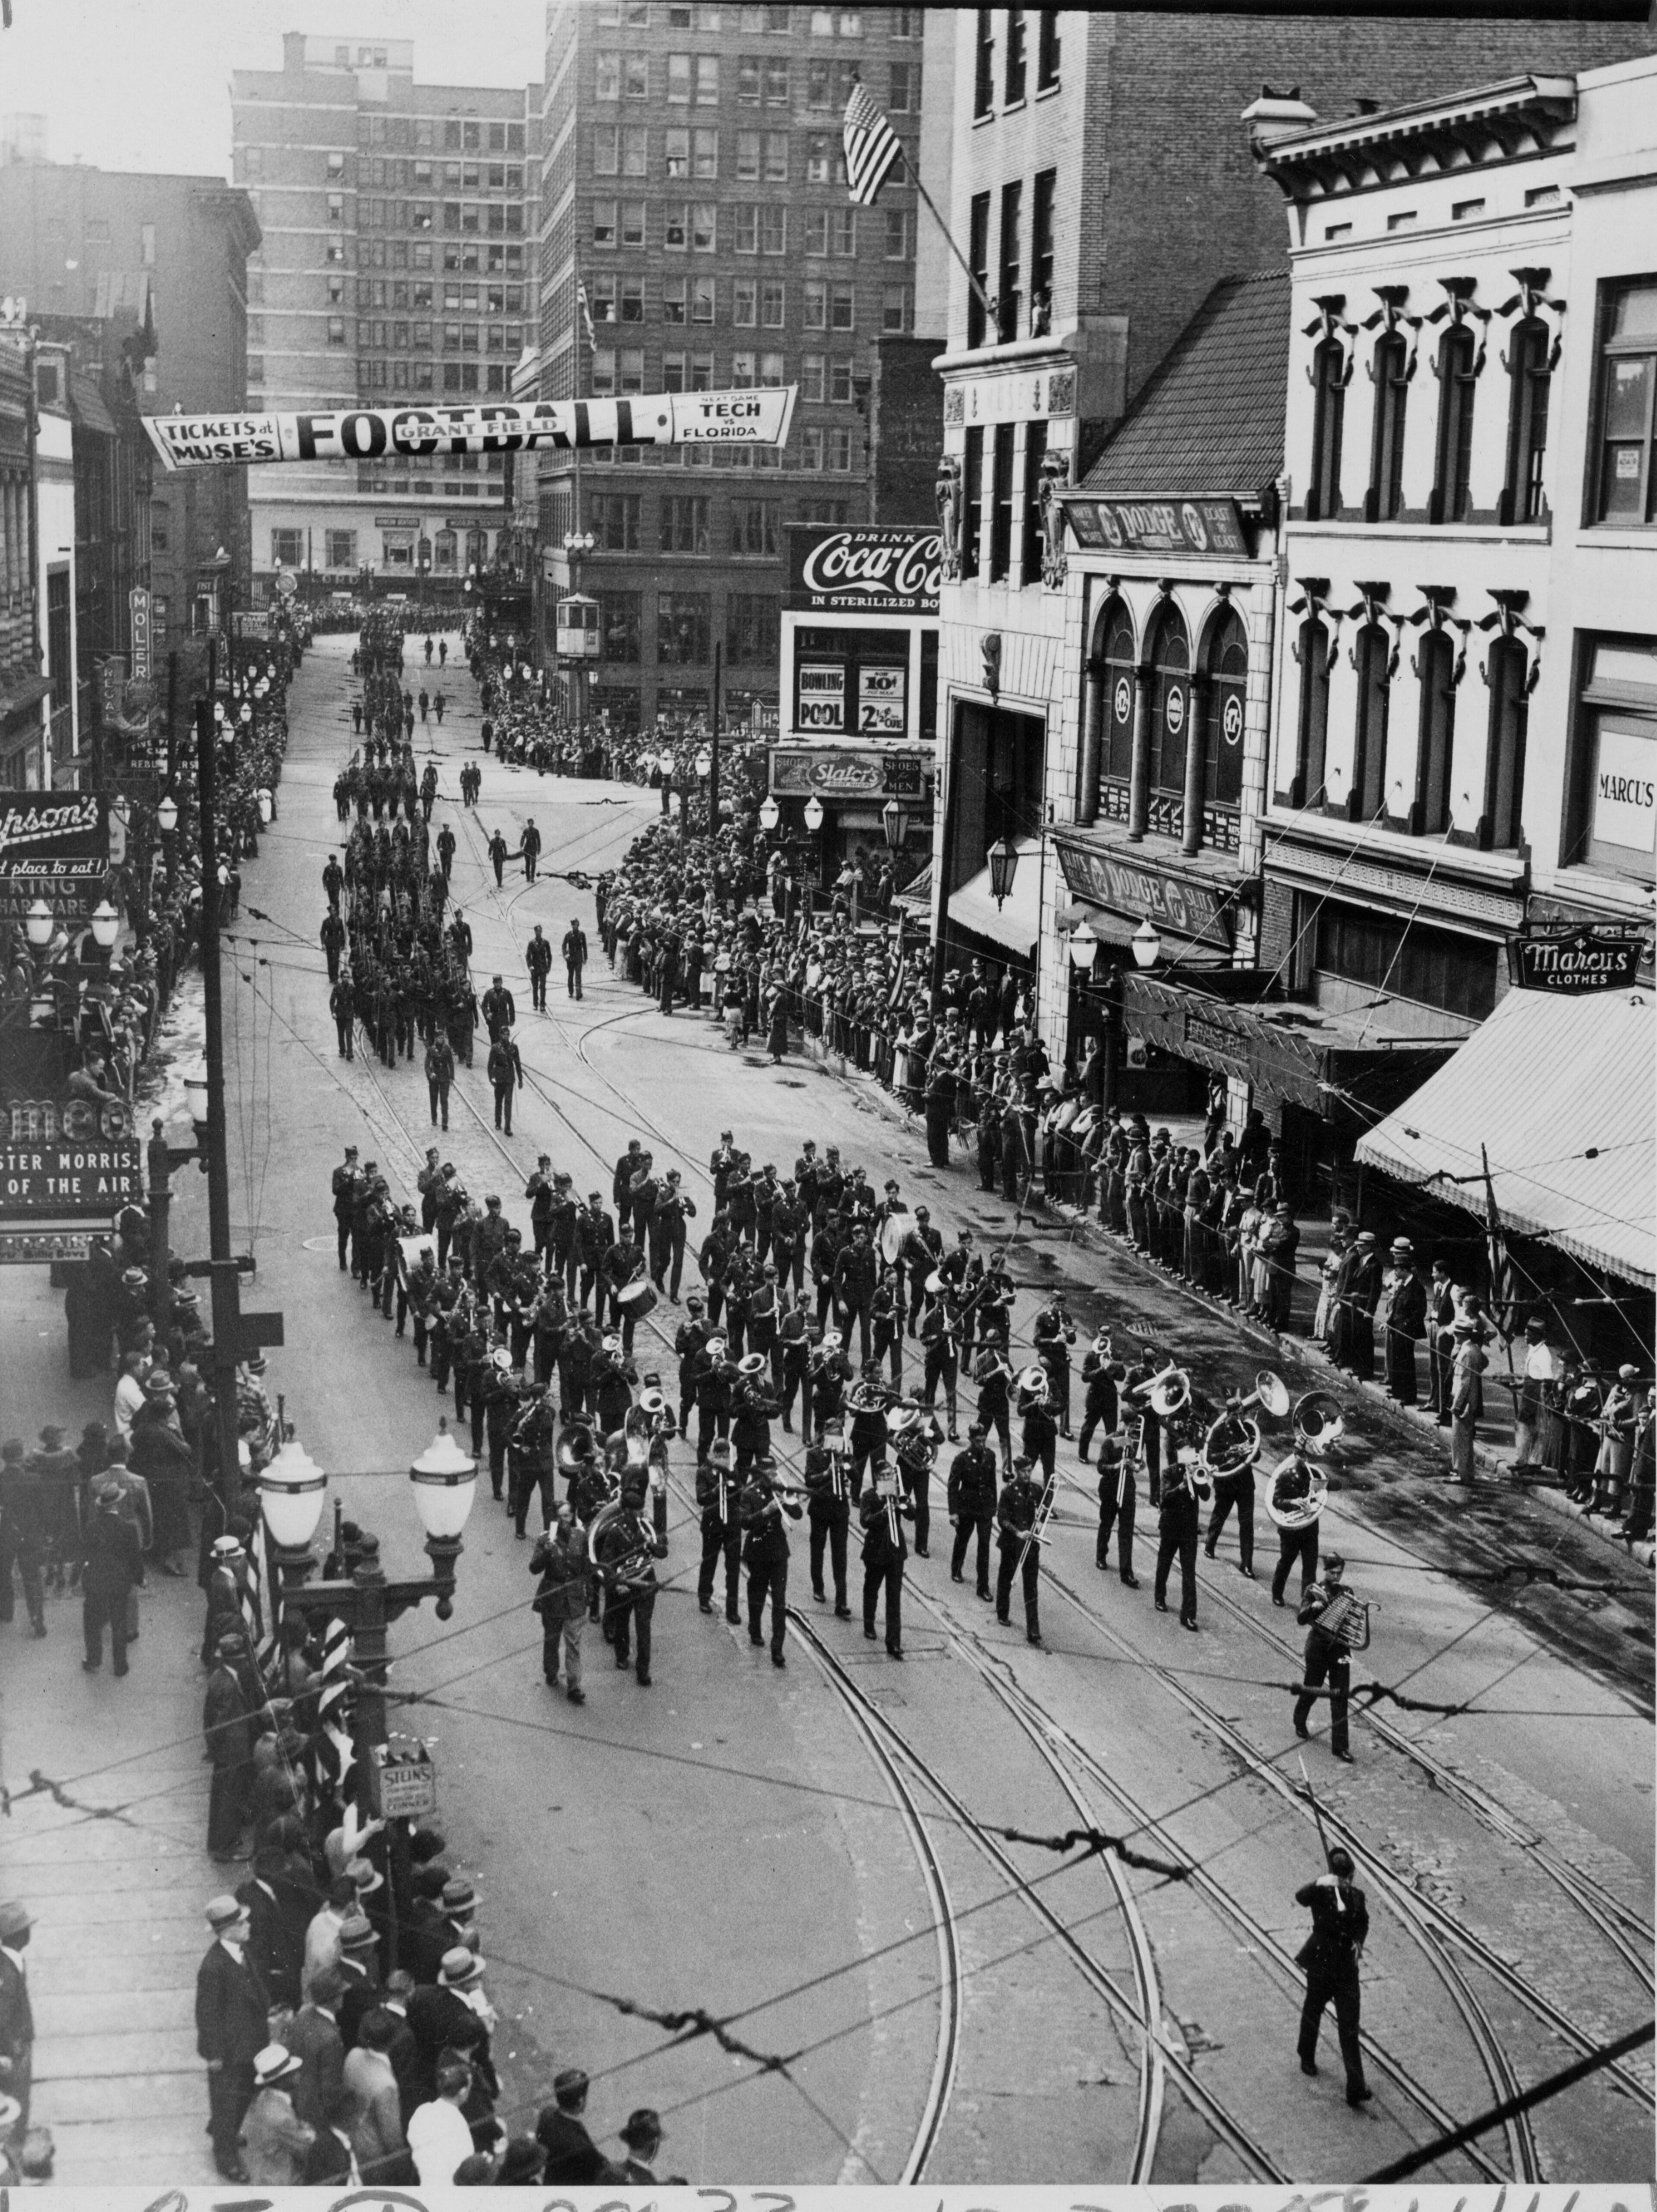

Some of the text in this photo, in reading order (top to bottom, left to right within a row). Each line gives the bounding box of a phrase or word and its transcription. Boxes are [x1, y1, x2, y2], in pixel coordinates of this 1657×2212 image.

[699, 403, 760, 417] TECH
[164, 420, 274, 441] TICKETS at
[296, 400, 655, 459] FOOTBALL
[401, 420, 558, 438] GRANT FIELD
[684, 427, 757, 438] FLORIDA
[173, 439, 274, 460] MUSE'S
[1116, 506, 1184, 539] DODGE
[854, 533, 916, 542] DRINK
[811, 595, 825, 605] IN
[830, 596, 915, 608] STERILIZED
[134, 595, 146, 678] MOLER
[801, 672, 843, 691] BOWLING
[800, 703, 843, 726] POOL
[884, 719, 902, 729] CUE
[131, 739, 152, 751] FIVE
[816, 764, 882, 783] Slater's
[885, 761, 919, 771] SHOES
[888, 782, 914, 792] MEN
[1599, 773, 1655, 808] MARCUS
[11, 860, 48, 878] place
[51, 860, 66, 874] to
[9, 879, 76, 895] KING
[1106, 863, 1168, 912] DODGE
[1184, 888, 1215, 913] SUITS
[1525, 943, 1628, 972] Marcus
[1547, 974, 1608, 985] CLOTHES
[59, 1152, 131, 1170] MORRIS
[8, 1176, 130, 1194] OF THE AIR
